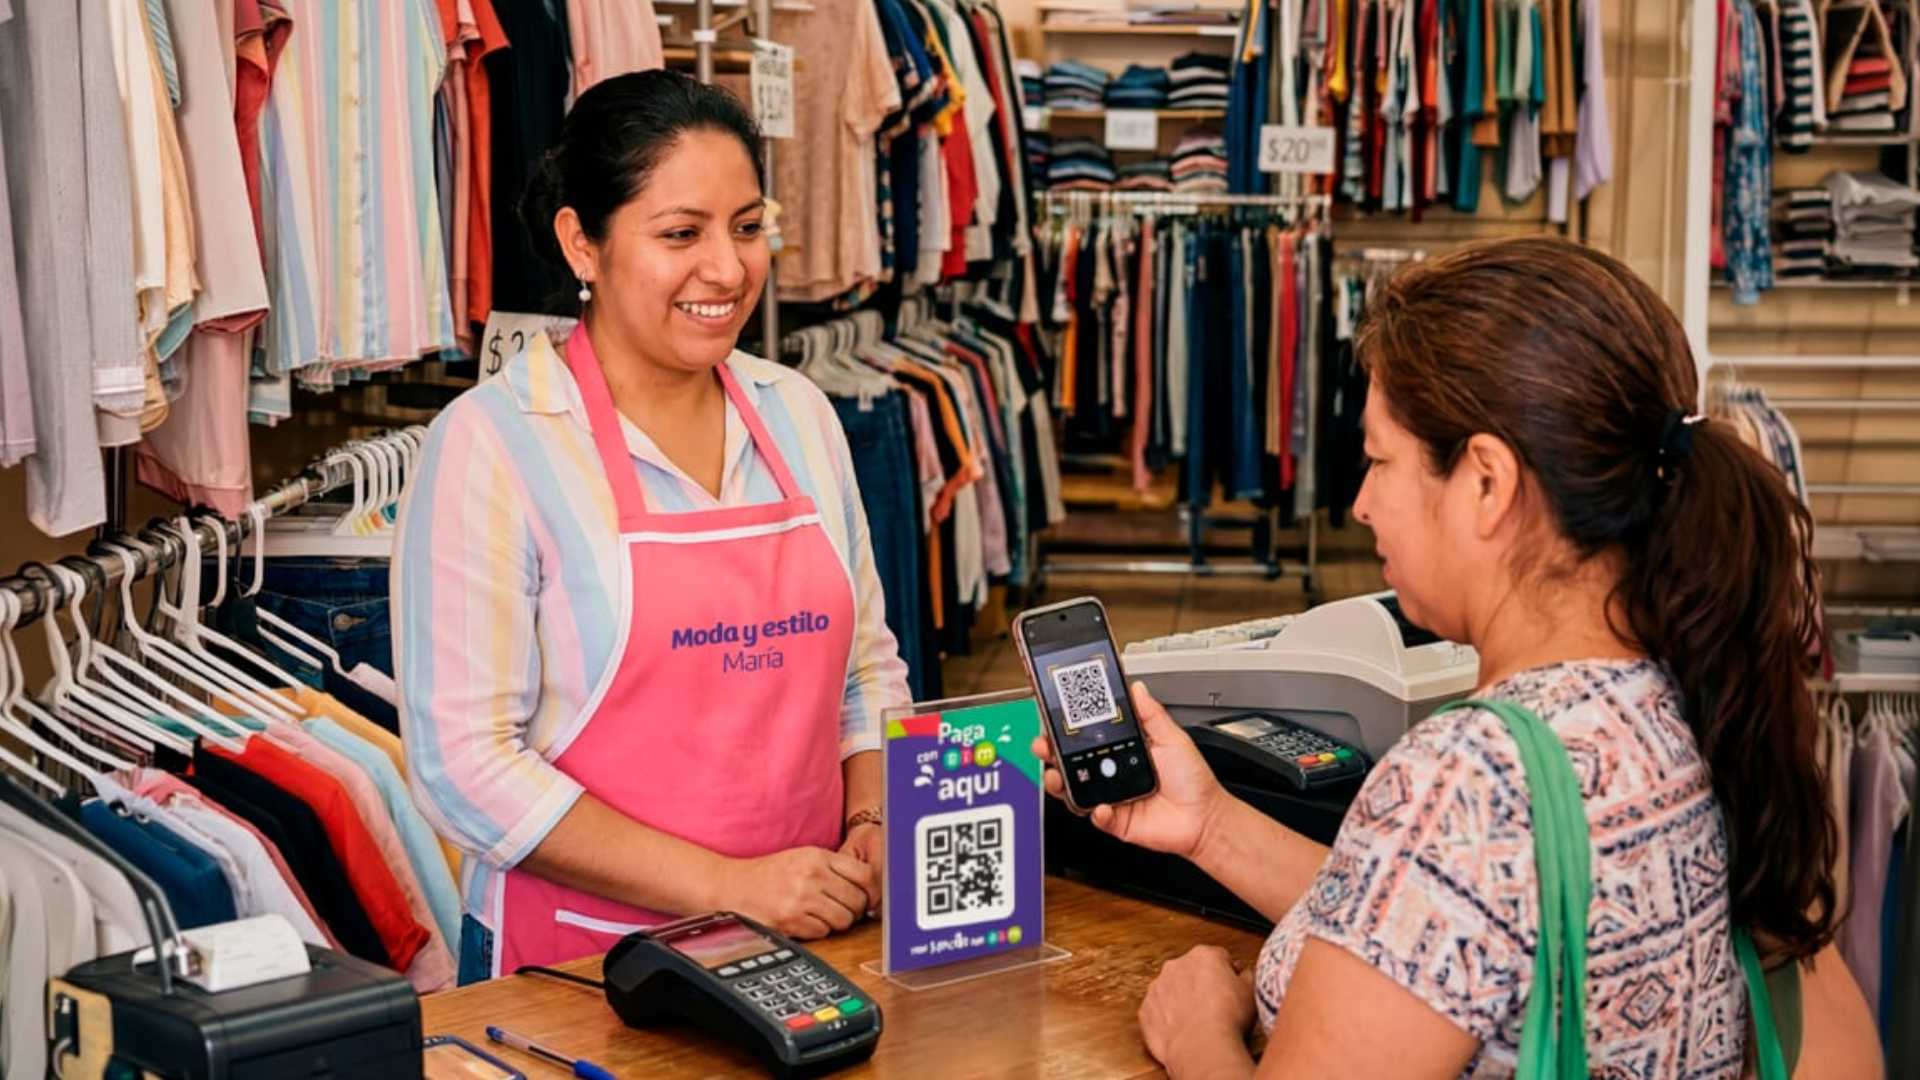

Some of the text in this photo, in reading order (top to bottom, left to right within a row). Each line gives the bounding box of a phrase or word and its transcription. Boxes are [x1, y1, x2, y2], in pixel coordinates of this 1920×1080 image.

[1268, 138, 1329, 162] $20
[486, 328, 537, 376] $2
[672, 611, 829, 649] Moda y estilo
[723, 646, 784, 673] María
[938, 721, 985, 747] Paga
[938, 760, 1002, 805] aquí
